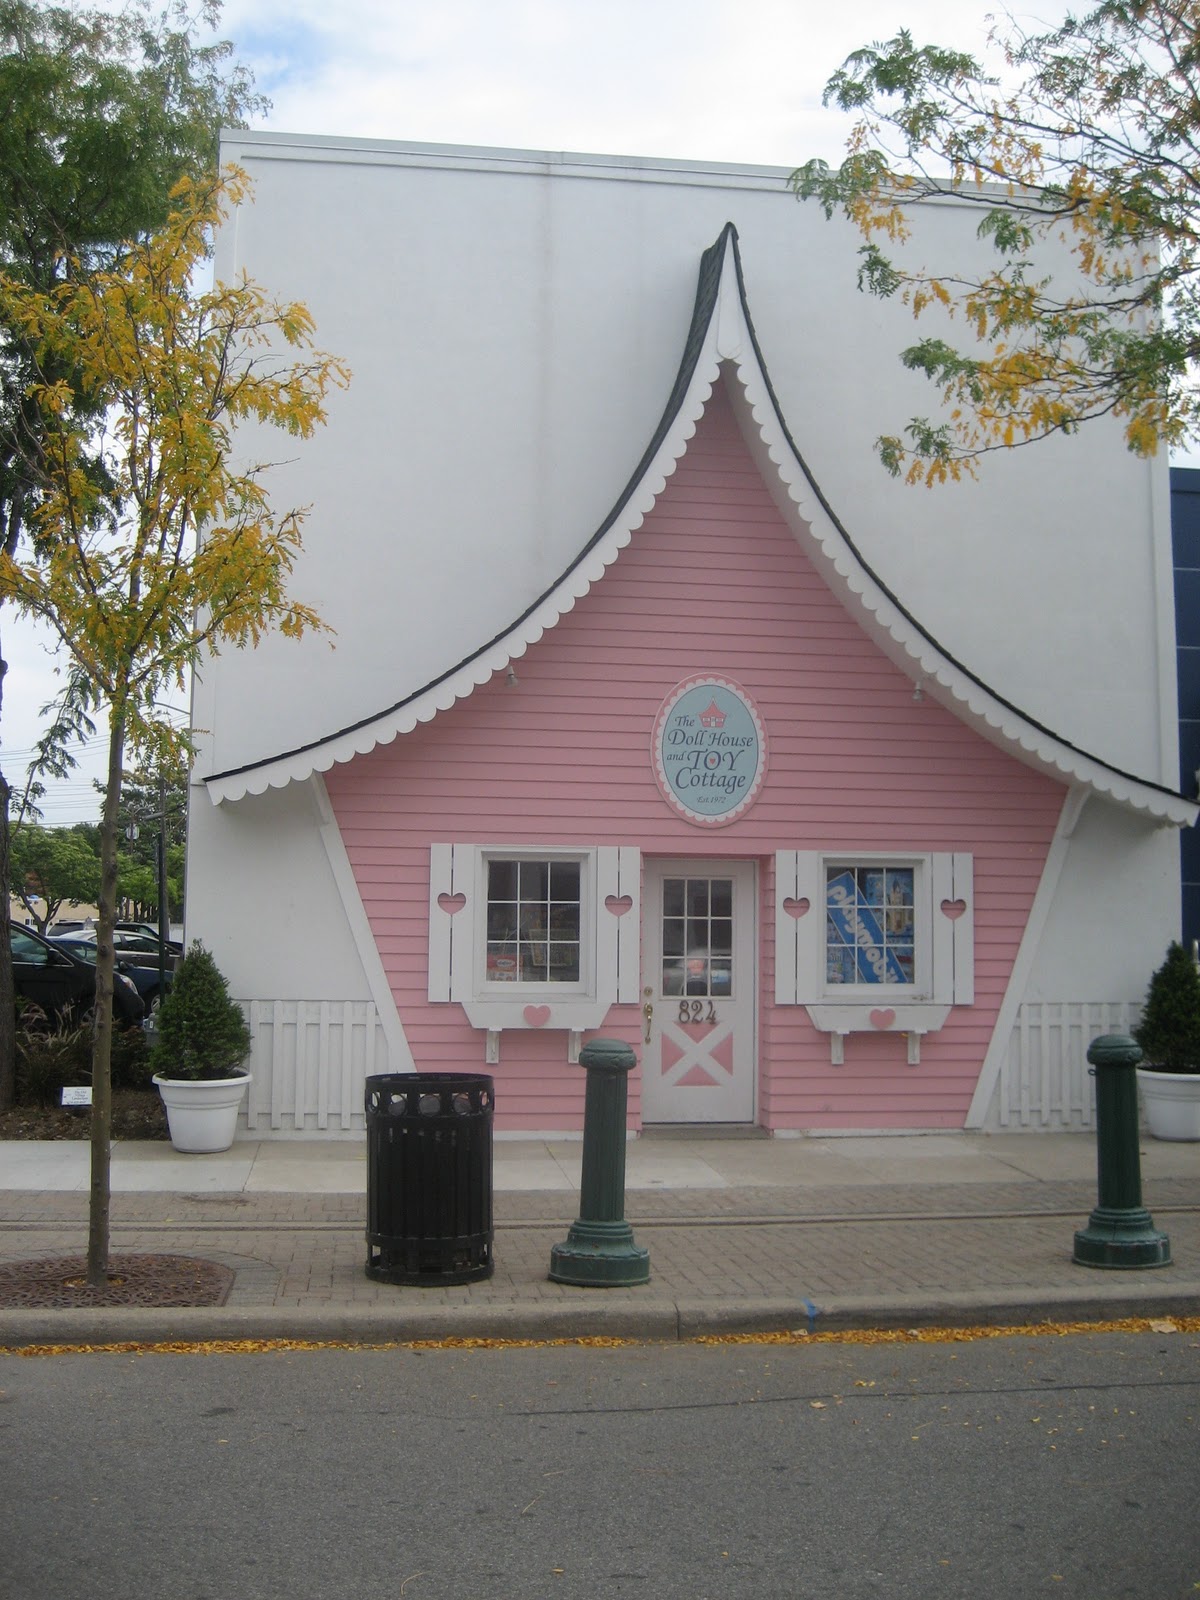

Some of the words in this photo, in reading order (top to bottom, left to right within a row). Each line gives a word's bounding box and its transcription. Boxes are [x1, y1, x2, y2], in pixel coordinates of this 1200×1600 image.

[674, 715, 695, 727] The
[667, 728, 708, 746] Doll
[708, 731, 754, 747] House
[666, 750, 687, 761] and
[687, 748, 745, 771] TOY
[675, 766, 746, 794] Cottage
[678, 1000, 716, 1025] 824
